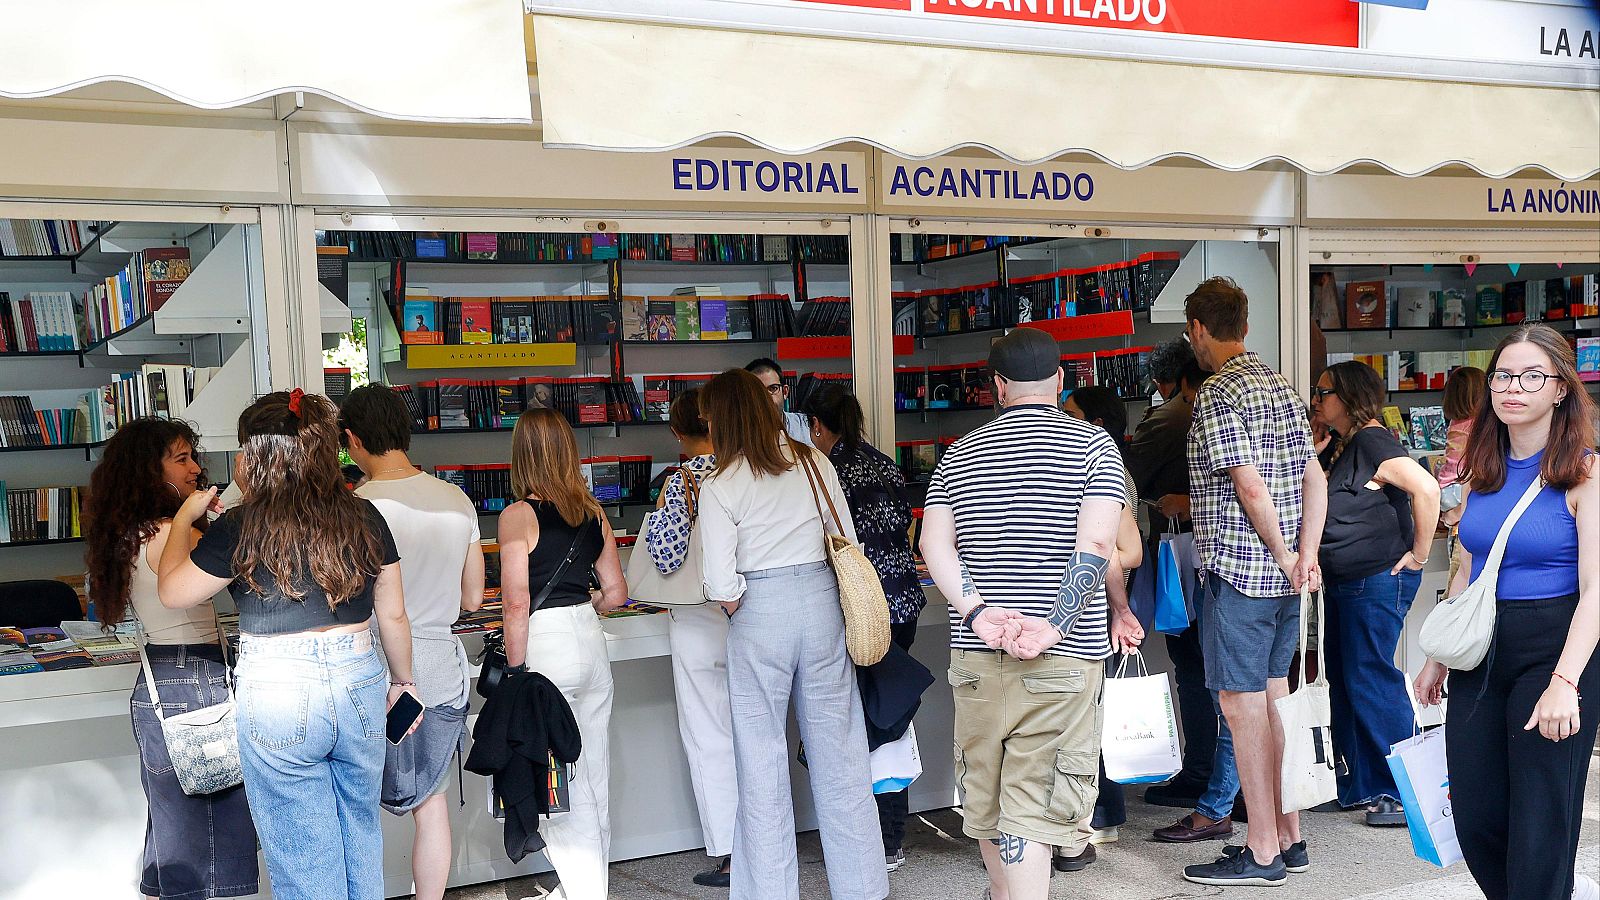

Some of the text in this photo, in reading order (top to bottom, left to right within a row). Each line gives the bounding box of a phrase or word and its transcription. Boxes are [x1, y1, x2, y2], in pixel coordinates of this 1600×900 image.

[930, 0, 1167, 25] ILADO
[1539, 26, 1600, 60] LA A
[672, 158, 1094, 201] EDITORIAL ACANTILADO
[1487, 188, 1516, 213] LA
